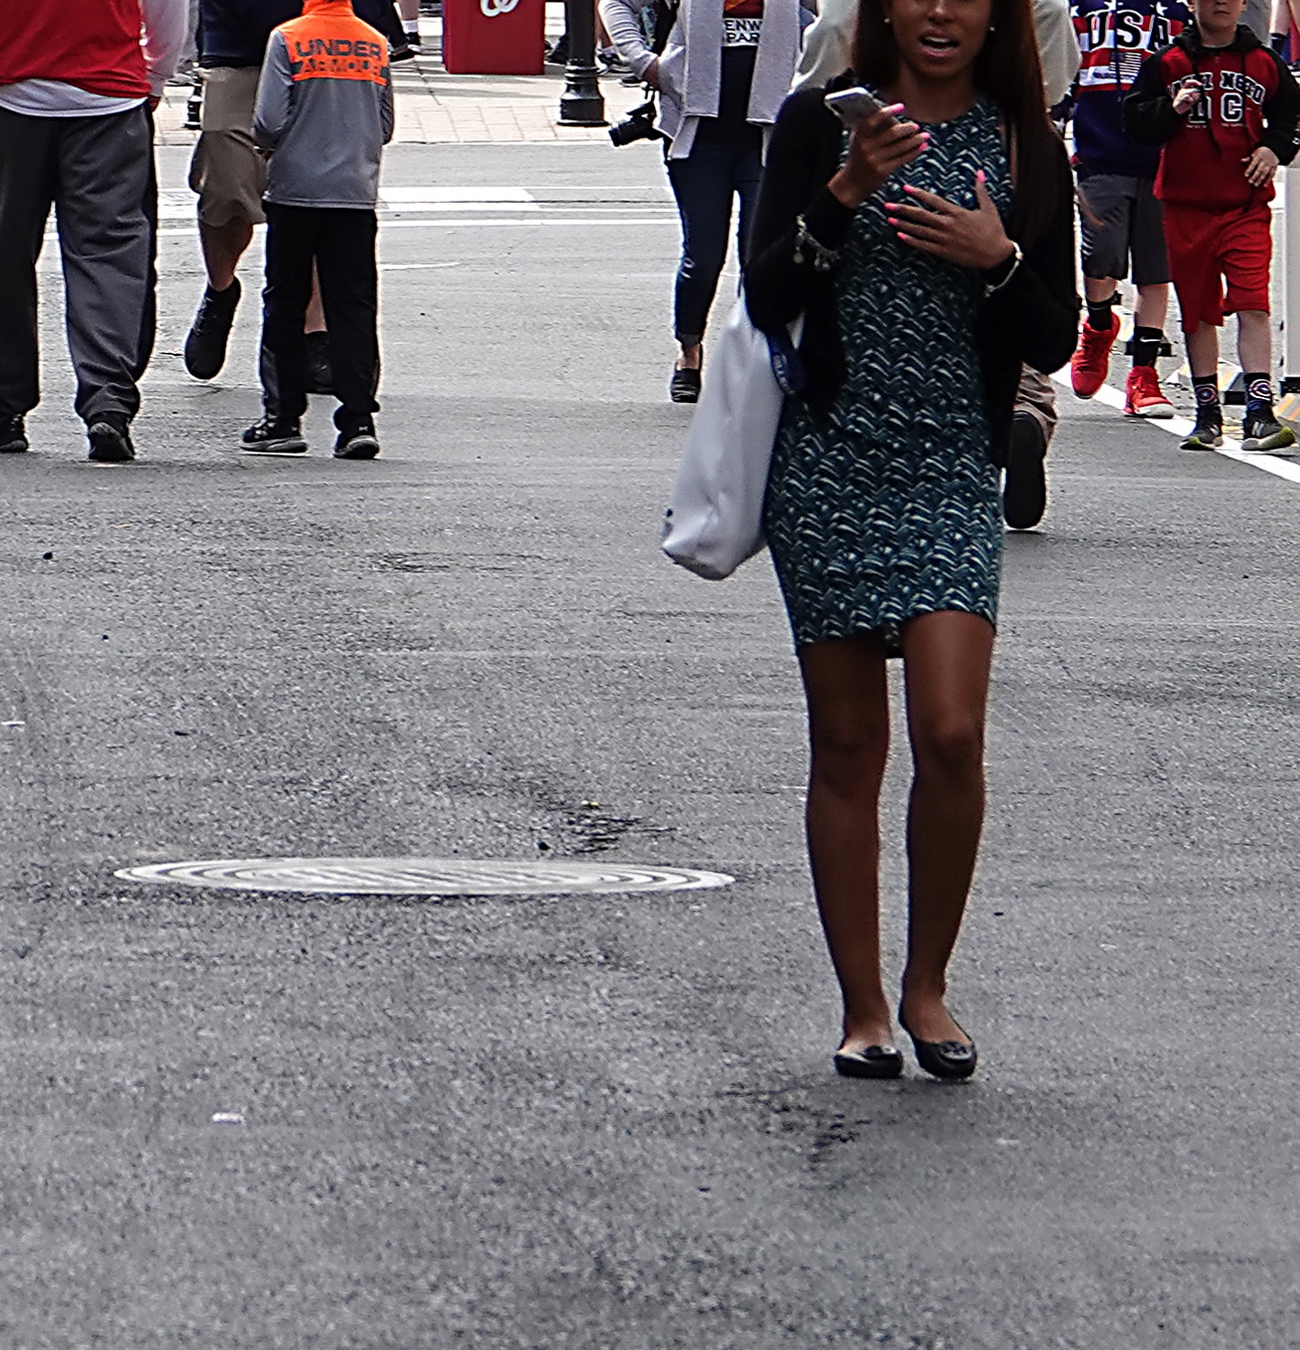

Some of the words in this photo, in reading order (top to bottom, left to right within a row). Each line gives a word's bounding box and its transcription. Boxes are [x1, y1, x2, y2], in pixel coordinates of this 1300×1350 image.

[724, 19, 763, 32] ENW
[1084, 8, 1172, 53] USA
[725, 32, 761, 44] PAR
[295, 38, 383, 62] UNDER
